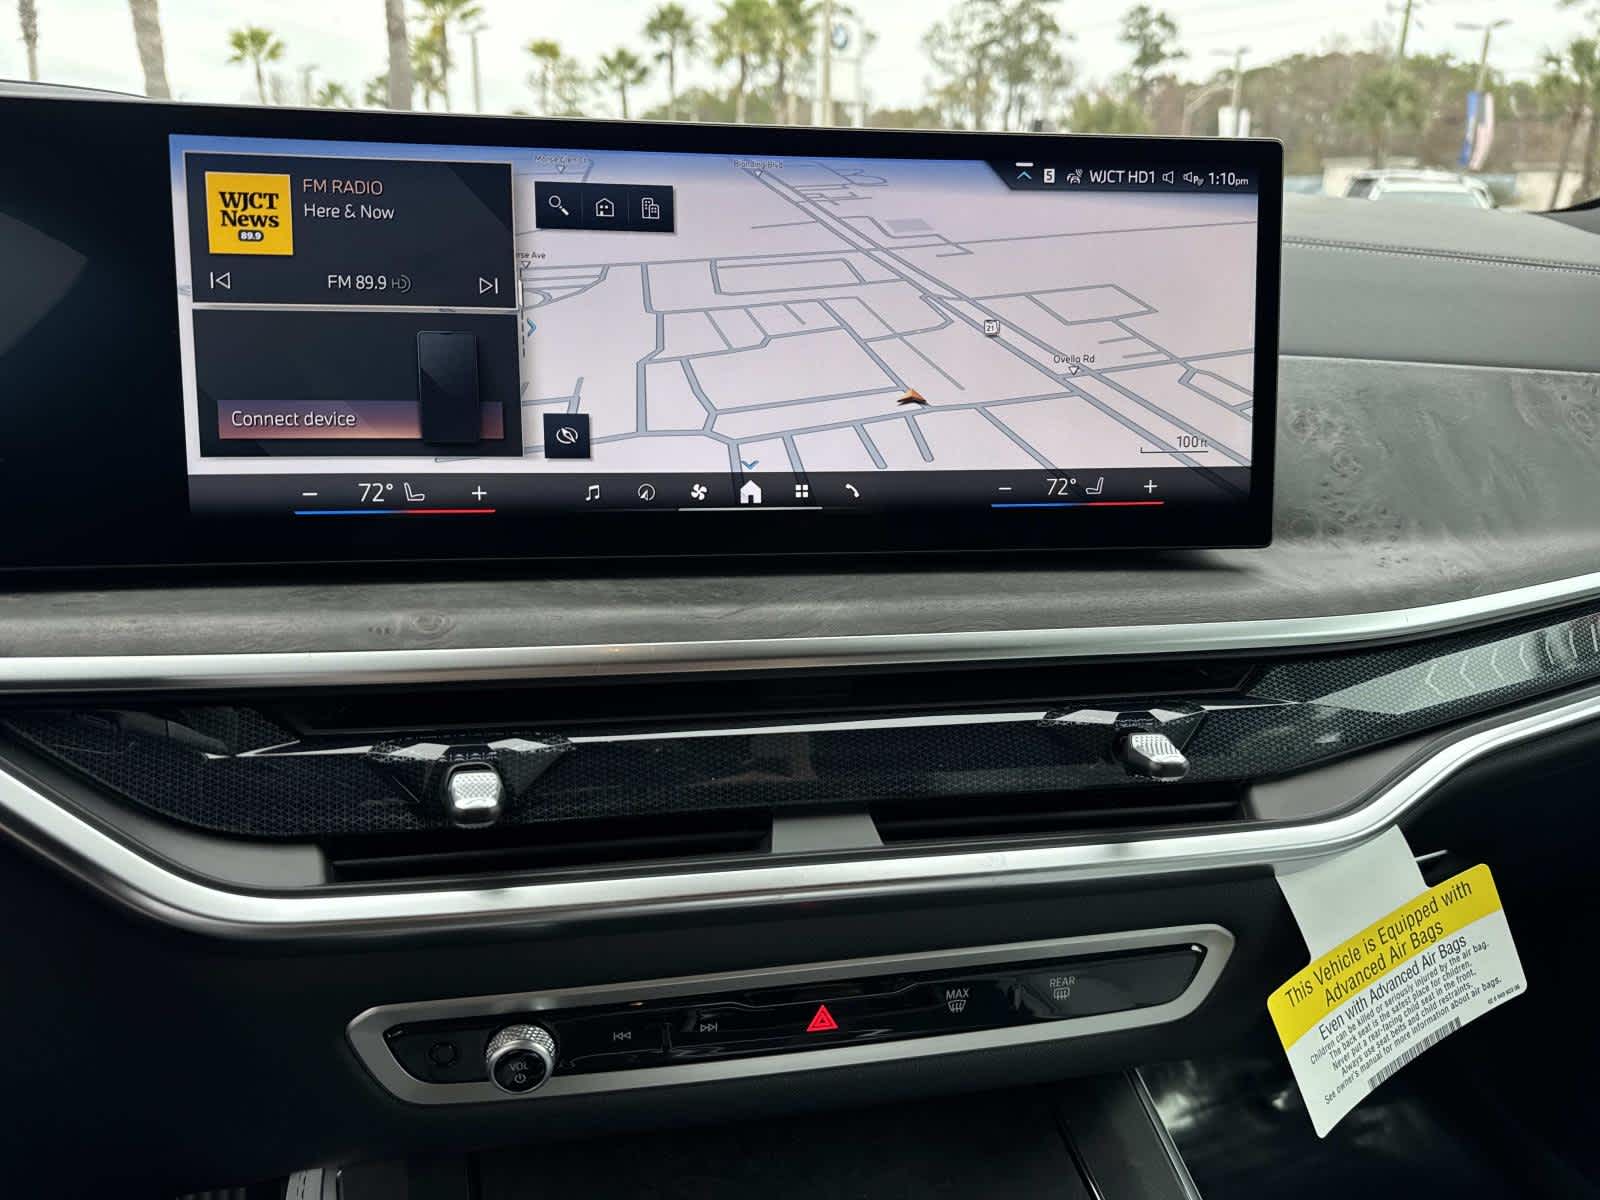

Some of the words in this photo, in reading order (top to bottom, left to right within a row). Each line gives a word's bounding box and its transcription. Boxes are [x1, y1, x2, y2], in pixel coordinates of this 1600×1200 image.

[1090, 170, 1125, 184] WJCT
[1128, 171, 1155, 183] HD1
[1208, 172, 1249, 187] 1:10pm
[303, 178, 327, 193] FM
[332, 179, 383, 195] RADIO
[219, 191, 279, 211] WJCT
[220, 210, 279, 228] News
[303, 203, 340, 219] Here
[345, 204, 356, 218] &
[361, 205, 395, 220] Now
[239, 231, 263, 241] 89.9
[327, 274, 351, 289] FM
[355, 275, 387, 290] 89.9
[1082, 354, 1095, 363] Rd
[231, 410, 298, 426] Connect
[304, 411, 357, 426] device
[1176, 436, 1199, 448] 100
[1201, 439, 1208, 447] ft
[357, 483, 394, 502] 72°
[1046, 478, 1077, 496] 72°
[1284, 980, 1314, 1008] This
[1313, 947, 1361, 985] Vehicle
[1362, 938, 1376, 955] is
[1377, 896, 1439, 944] Equipped
[1441, 881, 1472, 906] with
[1325, 953, 1386, 1007] Advanced
[1389, 941, 1407, 964] Air
[1409, 921, 1444, 949] Bags
[1049, 976, 1076, 988] REAR
[1319, 1014, 1345, 1040] Even
[1345, 996, 1368, 1020] with
[1370, 960, 1420, 1004] Advanced
[1422, 951, 1436, 970] Air
[1438, 936, 1467, 959] Bags
[946, 988, 969, 1000] MAX
[1310, 1039, 1335, 1064] Children
[1335, 1030, 1347, 1043] can
[1347, 1023, 1356, 1034] be
[1357, 1007, 1375, 1027] killed
[1376, 1004, 1383, 1014] or
[1385, 983, 1414, 1008] seriously
[1414, 968, 1438, 988] injured
[1449, 955, 1460, 966] the
[1462, 948, 1471, 959] air
[1328, 1047, 1341, 1060] The
[1341, 1034, 1357, 1050] back
[1358, 1023, 1372, 1039] seat
[1379, 1010, 1390, 1022] the
[1391, 996, 1411, 1014] safest
[1412, 985, 1430, 1002] place
[1430, 978, 1440, 988] for
[1442, 961, 1472, 982] children.
[1332, 1052, 1350, 1071] Never
[1351, 1043, 1362, 1057] put
[1368, 1014, 1403, 1040] rear-facing
[1403, 1000, 1420, 1018] child
[1421, 992, 1435, 1007] seat
[1443, 980, 1455, 991] the
[1341, 1056, 1363, 1077] Always
[1363, 1045, 1375, 1058] use
[1376, 1033, 1390, 1049] seat
[1390, 1023, 1407, 1038] belts
[1407, 1012, 1420, 1026] and
[1421, 1001, 1437, 1017] child
[1438, 982, 1473, 1007] restraints.
[1324, 1091, 1336, 1105] See
[1360, 1050, 1383, 1073] manual
[1383, 1044, 1393, 1055] for
[1393, 1031, 1411, 1048] more
[1411, 1006, 1450, 1035] information
[1450, 992, 1470, 1010] about
[1471, 987, 1481, 998] air
[508, 1062, 529, 1072] VOL
